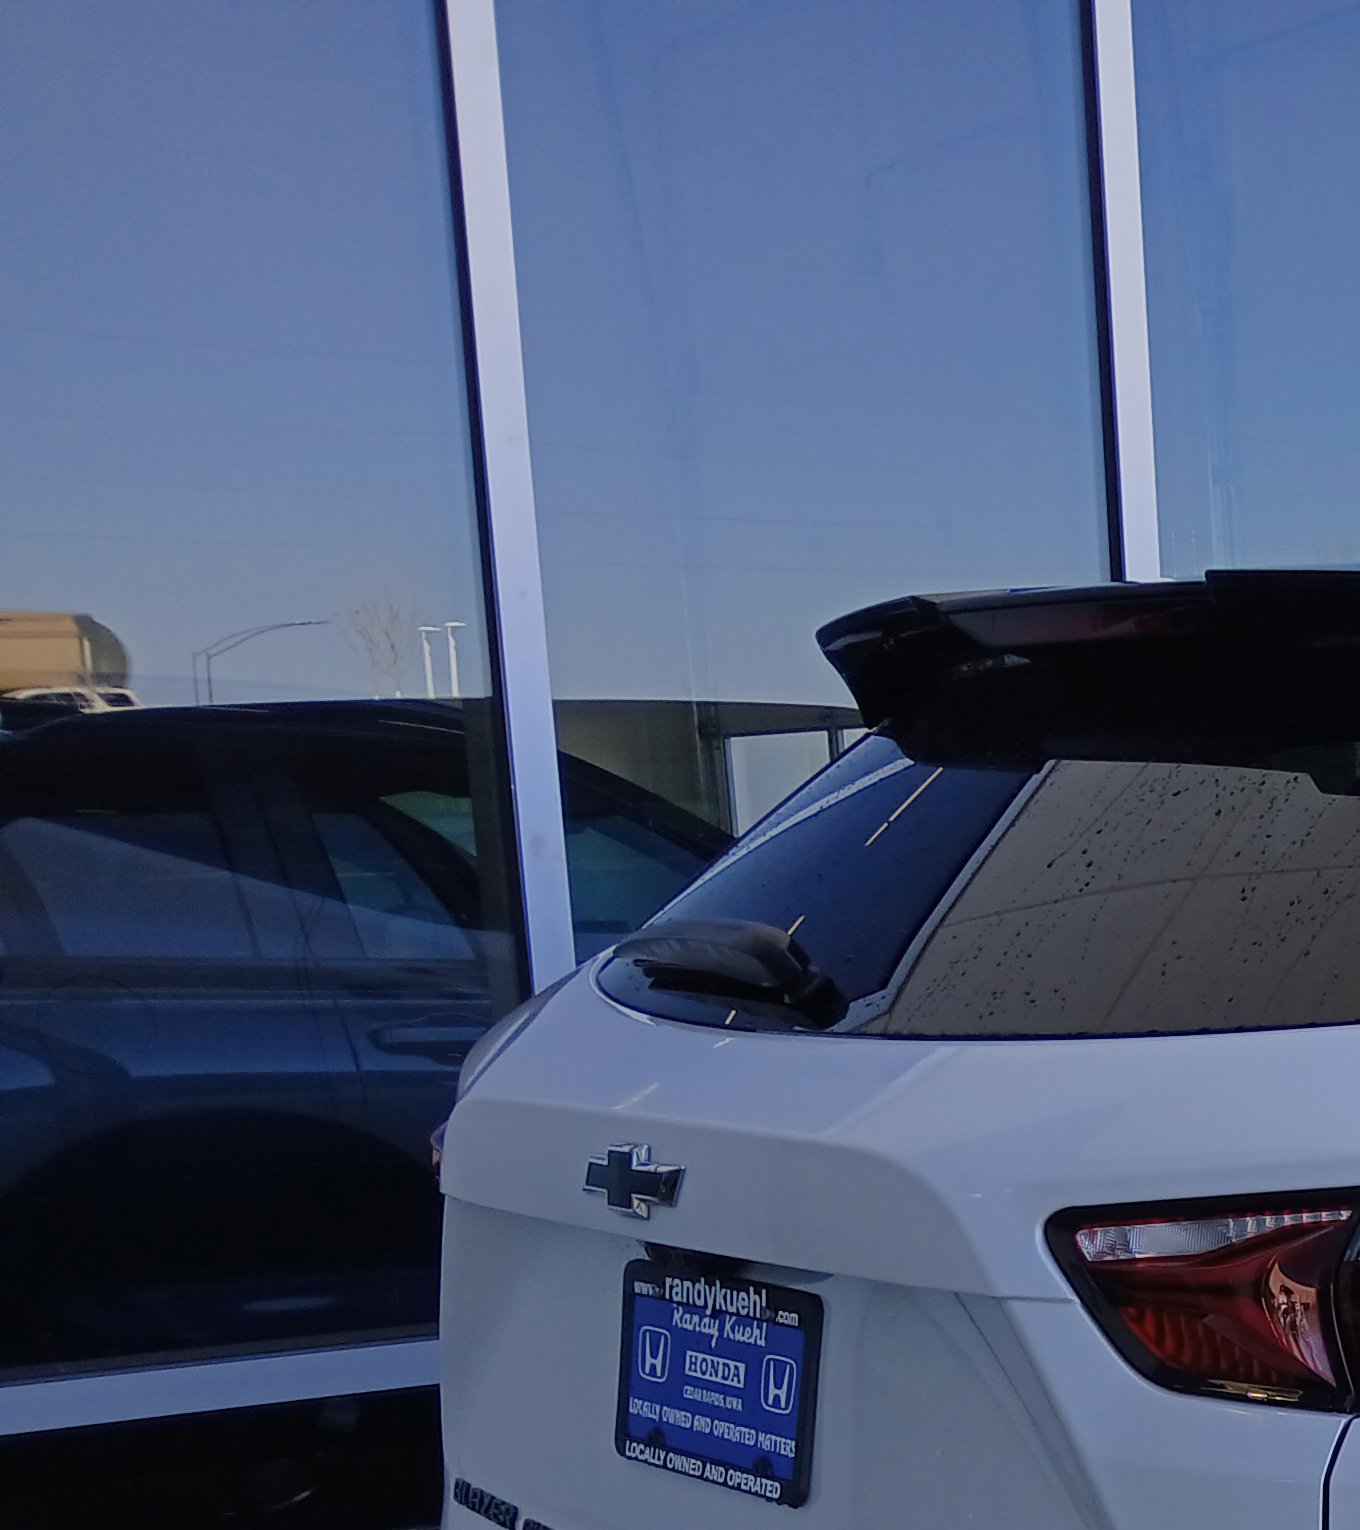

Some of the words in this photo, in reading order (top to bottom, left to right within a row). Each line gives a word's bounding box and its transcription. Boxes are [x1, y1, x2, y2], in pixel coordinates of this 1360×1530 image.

[664, 1276, 767, 1318] randykuehl
[776, 1310, 799, 1326] .com
[672, 1304, 719, 1348] Randy
[723, 1315, 767, 1347] Kuehl
[687, 1354, 742, 1385] HONDA
[629, 1397, 661, 1421] LOCALLY
[662, 1406, 692, 1429] OWNED
[693, 1414, 712, 1434] AND
[712, 1418, 756, 1446] OPERATED
[625, 1440, 667, 1467] LOCALLY
[666, 1452, 703, 1477] OWNED
[703, 1460, 726, 1483] AND
[726, 1468, 781, 1500] OPERATED
